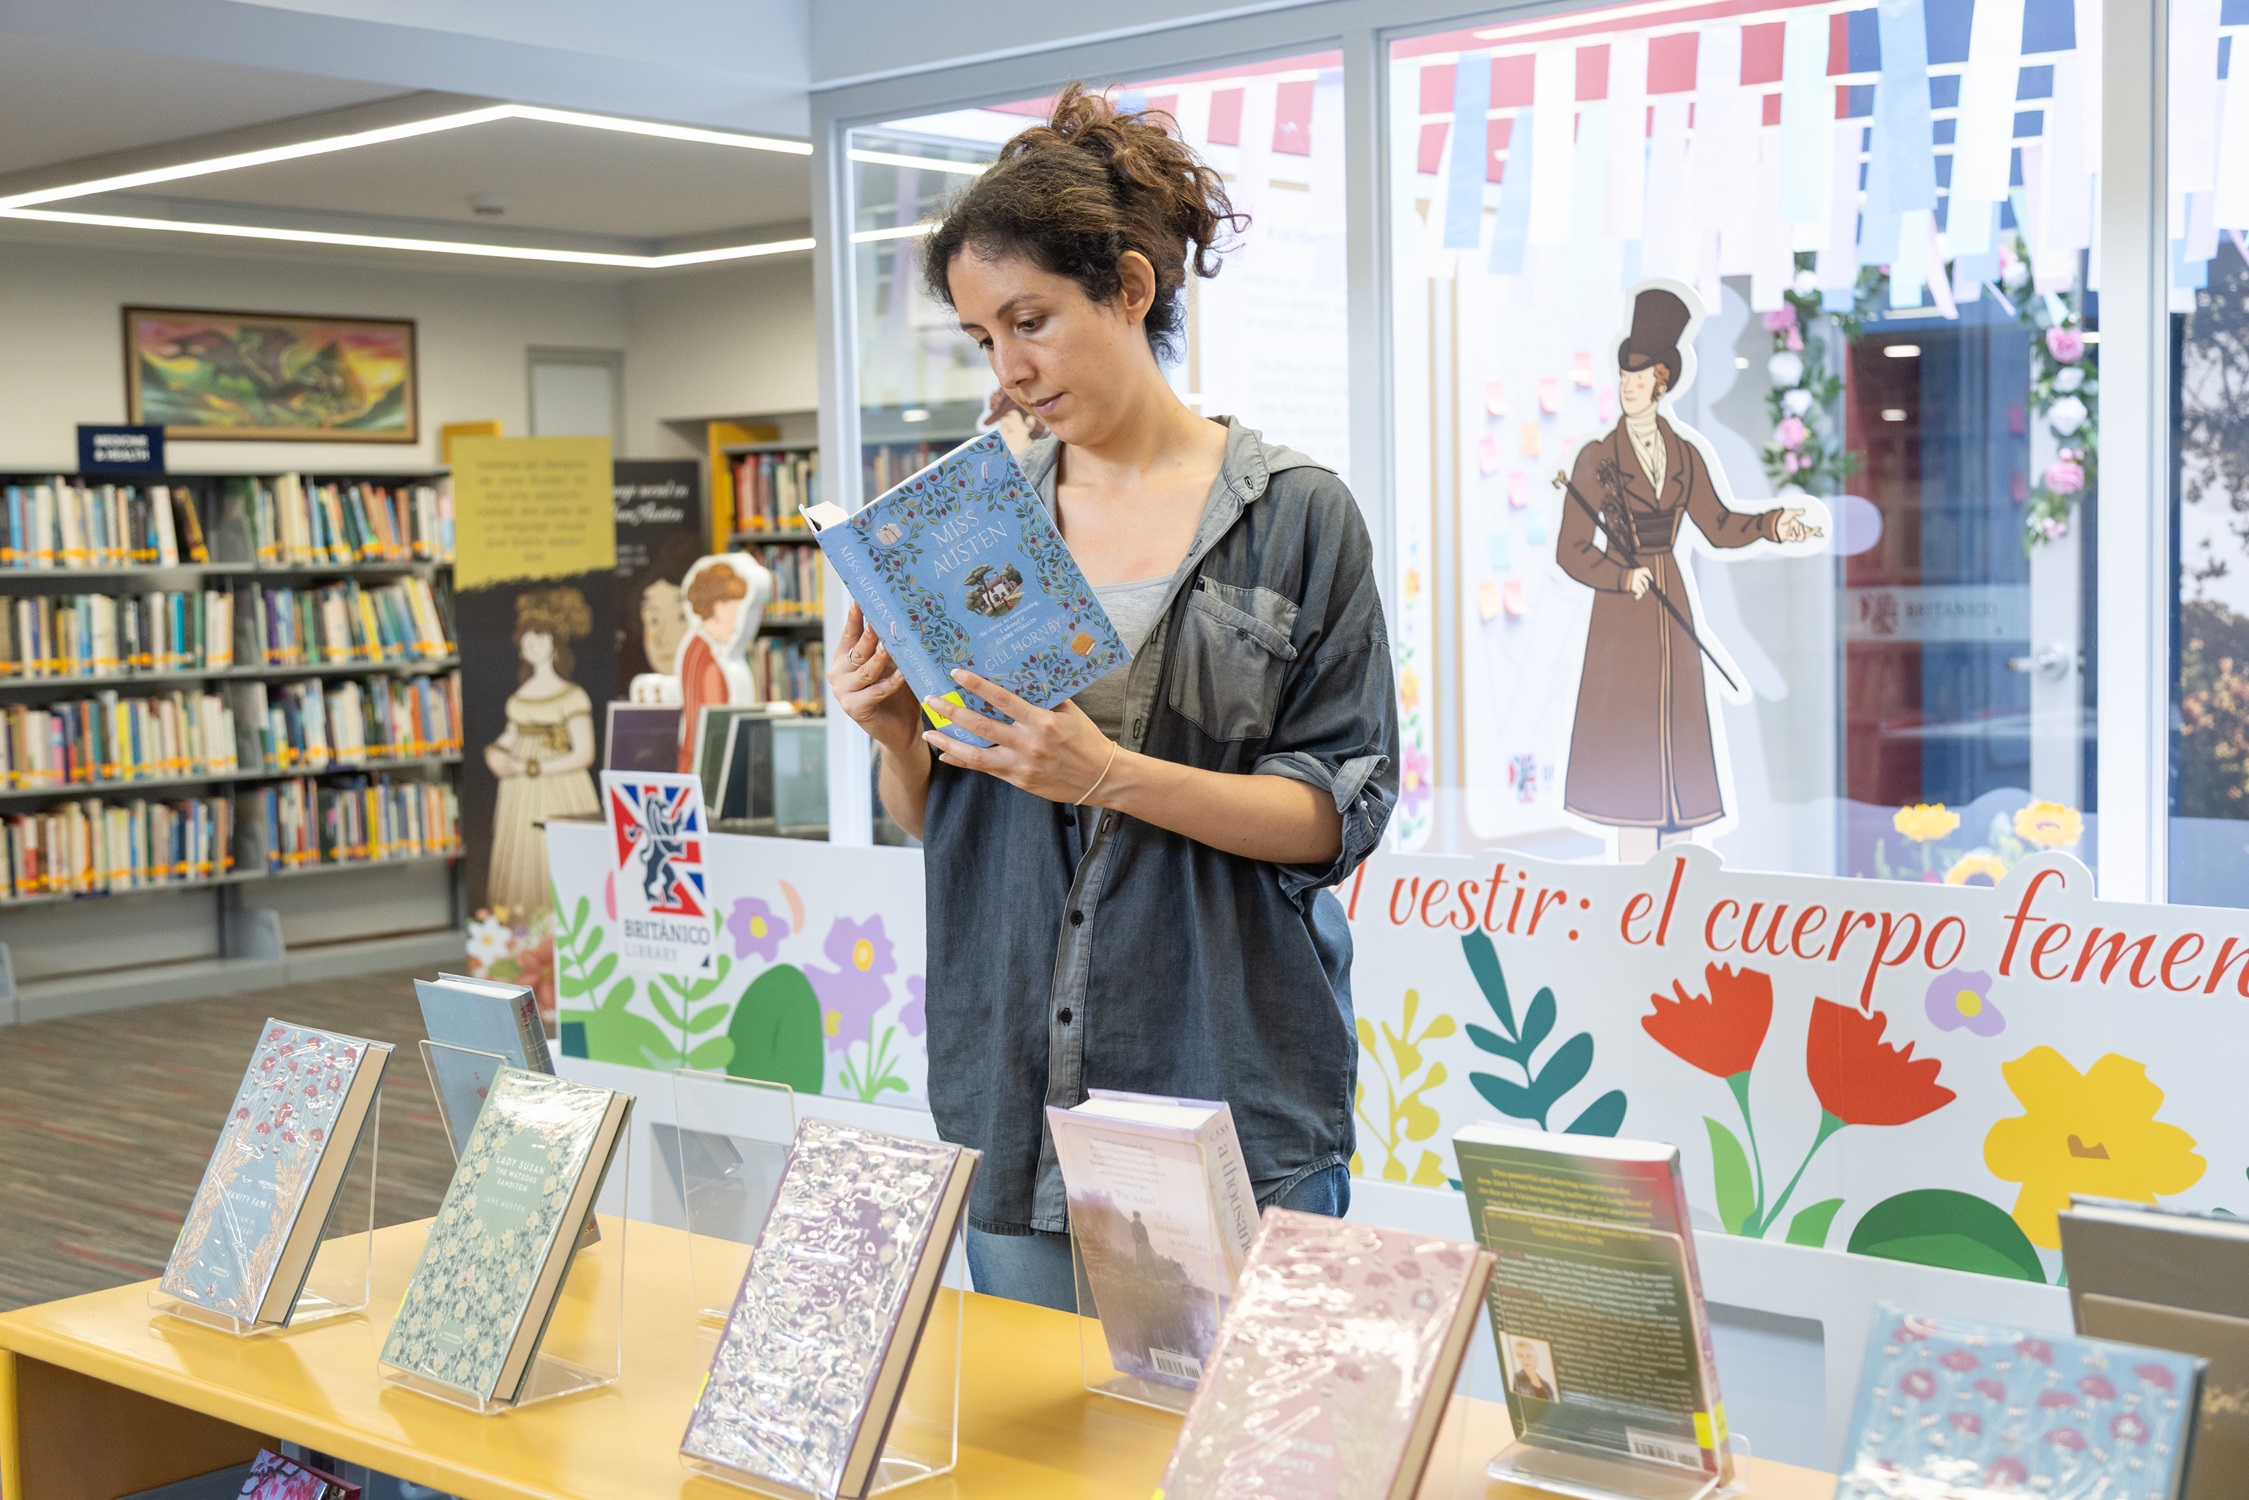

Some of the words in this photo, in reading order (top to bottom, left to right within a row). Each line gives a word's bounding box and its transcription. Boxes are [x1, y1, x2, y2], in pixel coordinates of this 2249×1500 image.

[930, 510, 980, 548] MISS
[933, 520, 1008, 579] AUSTEN
[839, 545, 860, 574] MISS
[856, 575, 892, 621] AUSTEN
[996, 631, 1014, 645] CLAIRE
[1013, 616, 1038, 634] TOMALIN
[985, 649, 1013, 671] GILL
[1010, 617, 1062, 655] HORNBY
[905, 649, 919, 669] GILL
[916, 667, 938, 696] HORN
[624, 918, 710, 946] BRITÁNICO
[1389, 863, 1591, 940] vestir:
[1620, 857, 1686, 946] el
[1704, 898, 1967, 1014] cuerpo
[1998, 868, 2249, 998] femen
[625, 942, 679, 962] LIBRARY
[1217, 1144, 1229, 1159] a
[496, 1154, 517, 1168] LADY
[519, 1160, 546, 1175] SUSAN
[496, 1167, 507, 1176] THE
[509, 1171, 538, 1184] WATSONS
[497, 1178, 529, 1193] SANDITON
[227, 1189, 251, 1205] VANITY
[251, 1197, 267, 1210] FAIR
[484, 1195, 500, 1206] JANE
[501, 1200, 526, 1213] AUSTEN
[1154, 1223, 1190, 1237] thousand
